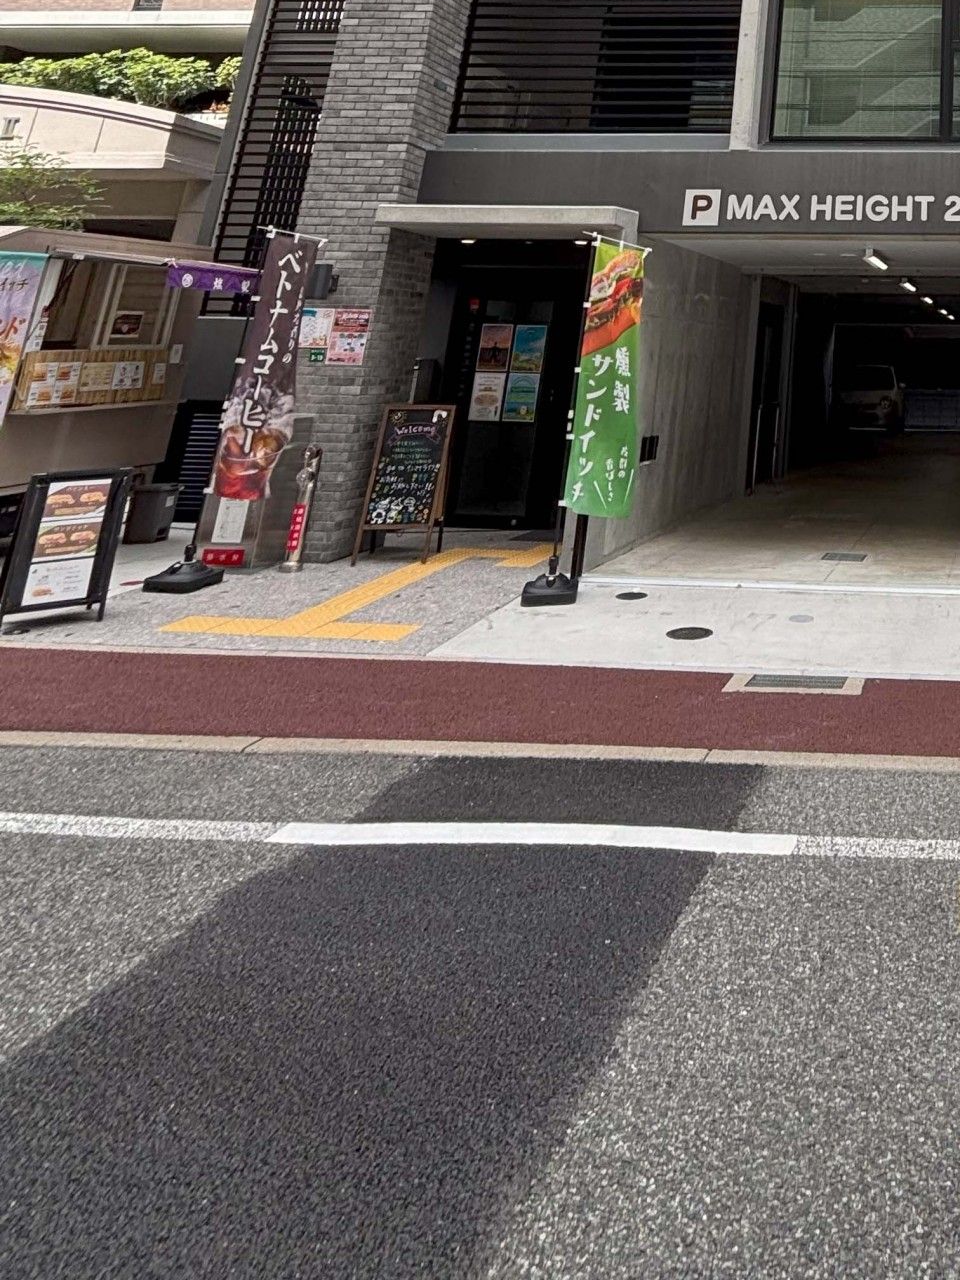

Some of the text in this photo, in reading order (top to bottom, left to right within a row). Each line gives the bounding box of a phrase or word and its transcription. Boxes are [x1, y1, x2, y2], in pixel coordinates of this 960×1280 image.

[691, 195, 713, 220] P
[726, 194, 800, 221] MAX
[810, 194, 935, 221] HEIGHT
[243, 250, 303, 454] ベトナムコーヒー
[394, 425, 436, 436] Welcome
[572, 353, 613, 504] サンドイッチ
